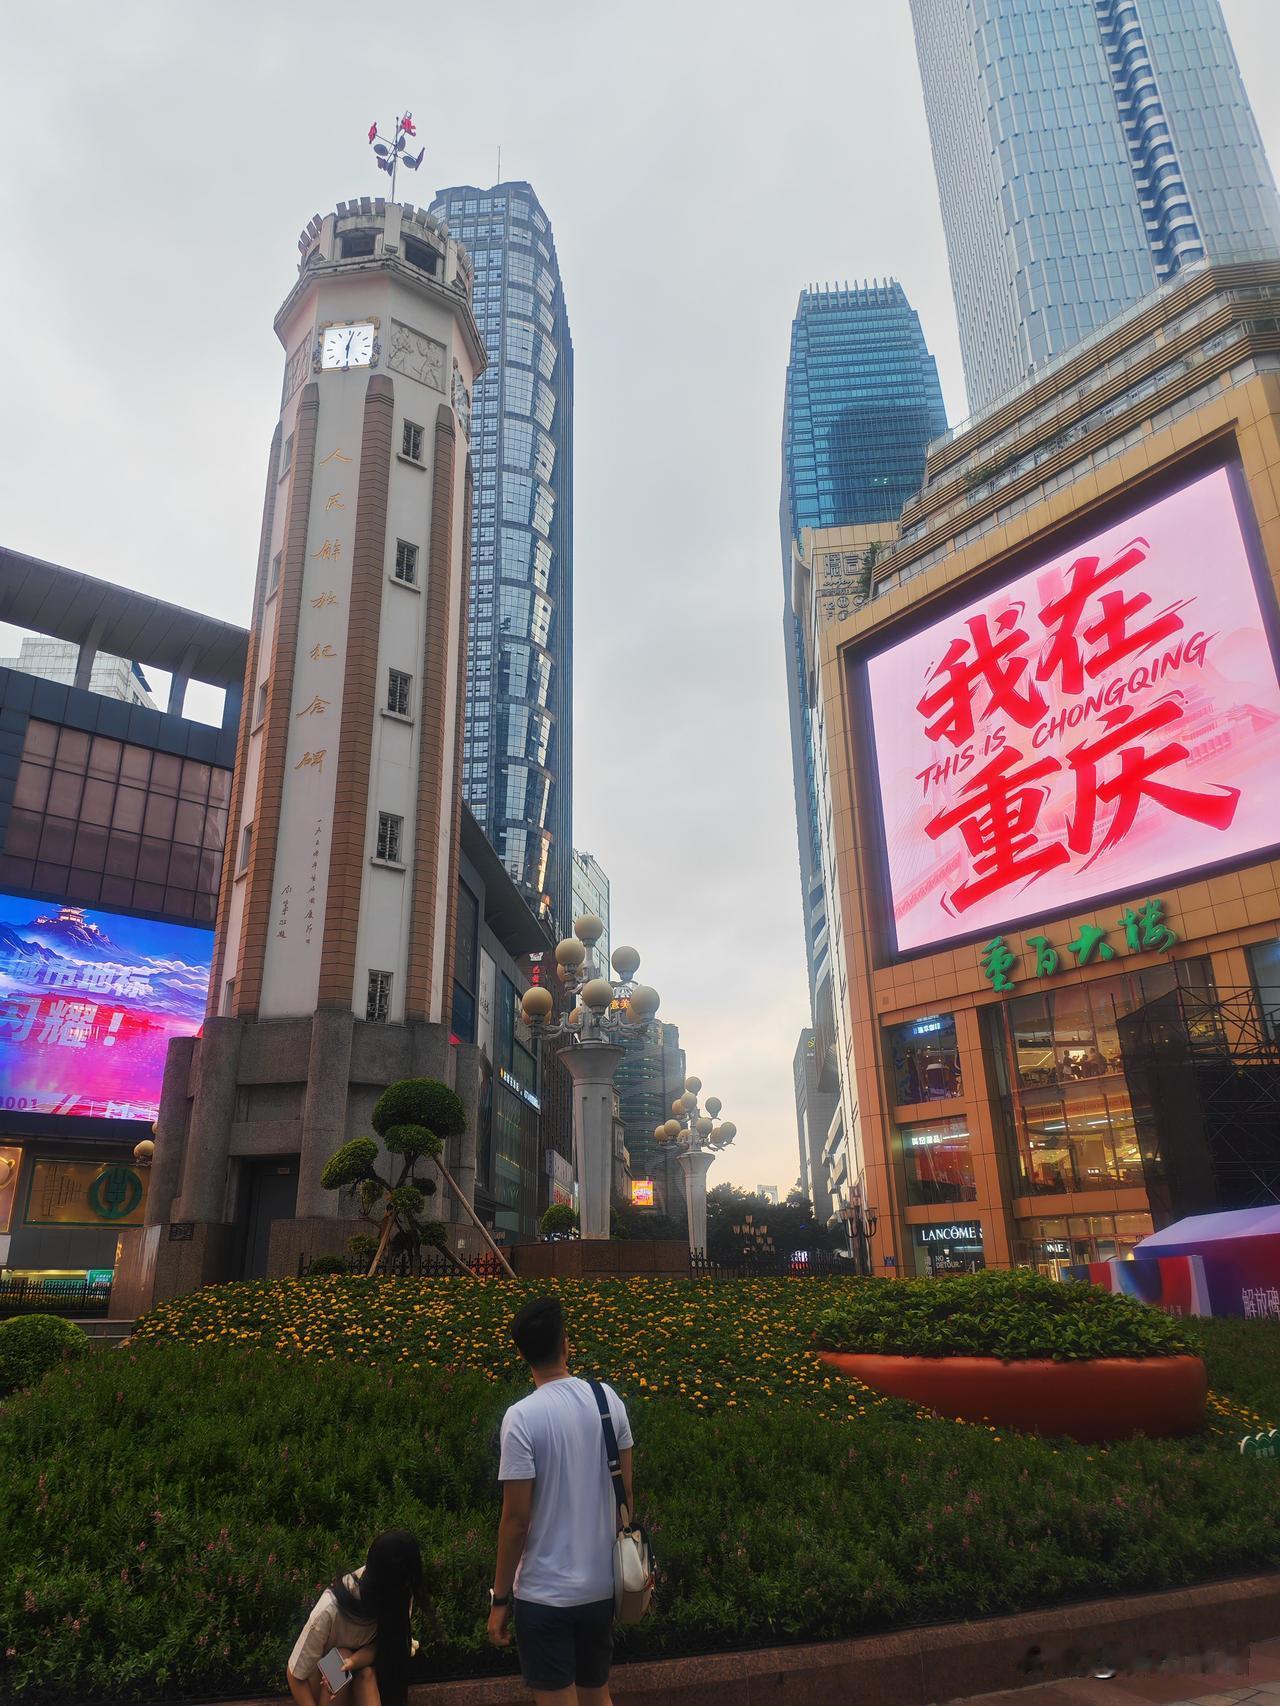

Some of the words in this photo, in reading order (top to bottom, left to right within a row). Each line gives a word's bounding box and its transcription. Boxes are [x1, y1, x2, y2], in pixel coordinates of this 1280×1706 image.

[916, 540, 1188, 748] 我在
[917, 746, 976, 798] THIS
[983, 726, 1007, 757] IS
[1031, 632, 1215, 750] CHONGQING
[924, 694, 1241, 915] 重庆
[922, 1225, 977, 1242] LANCÔME
